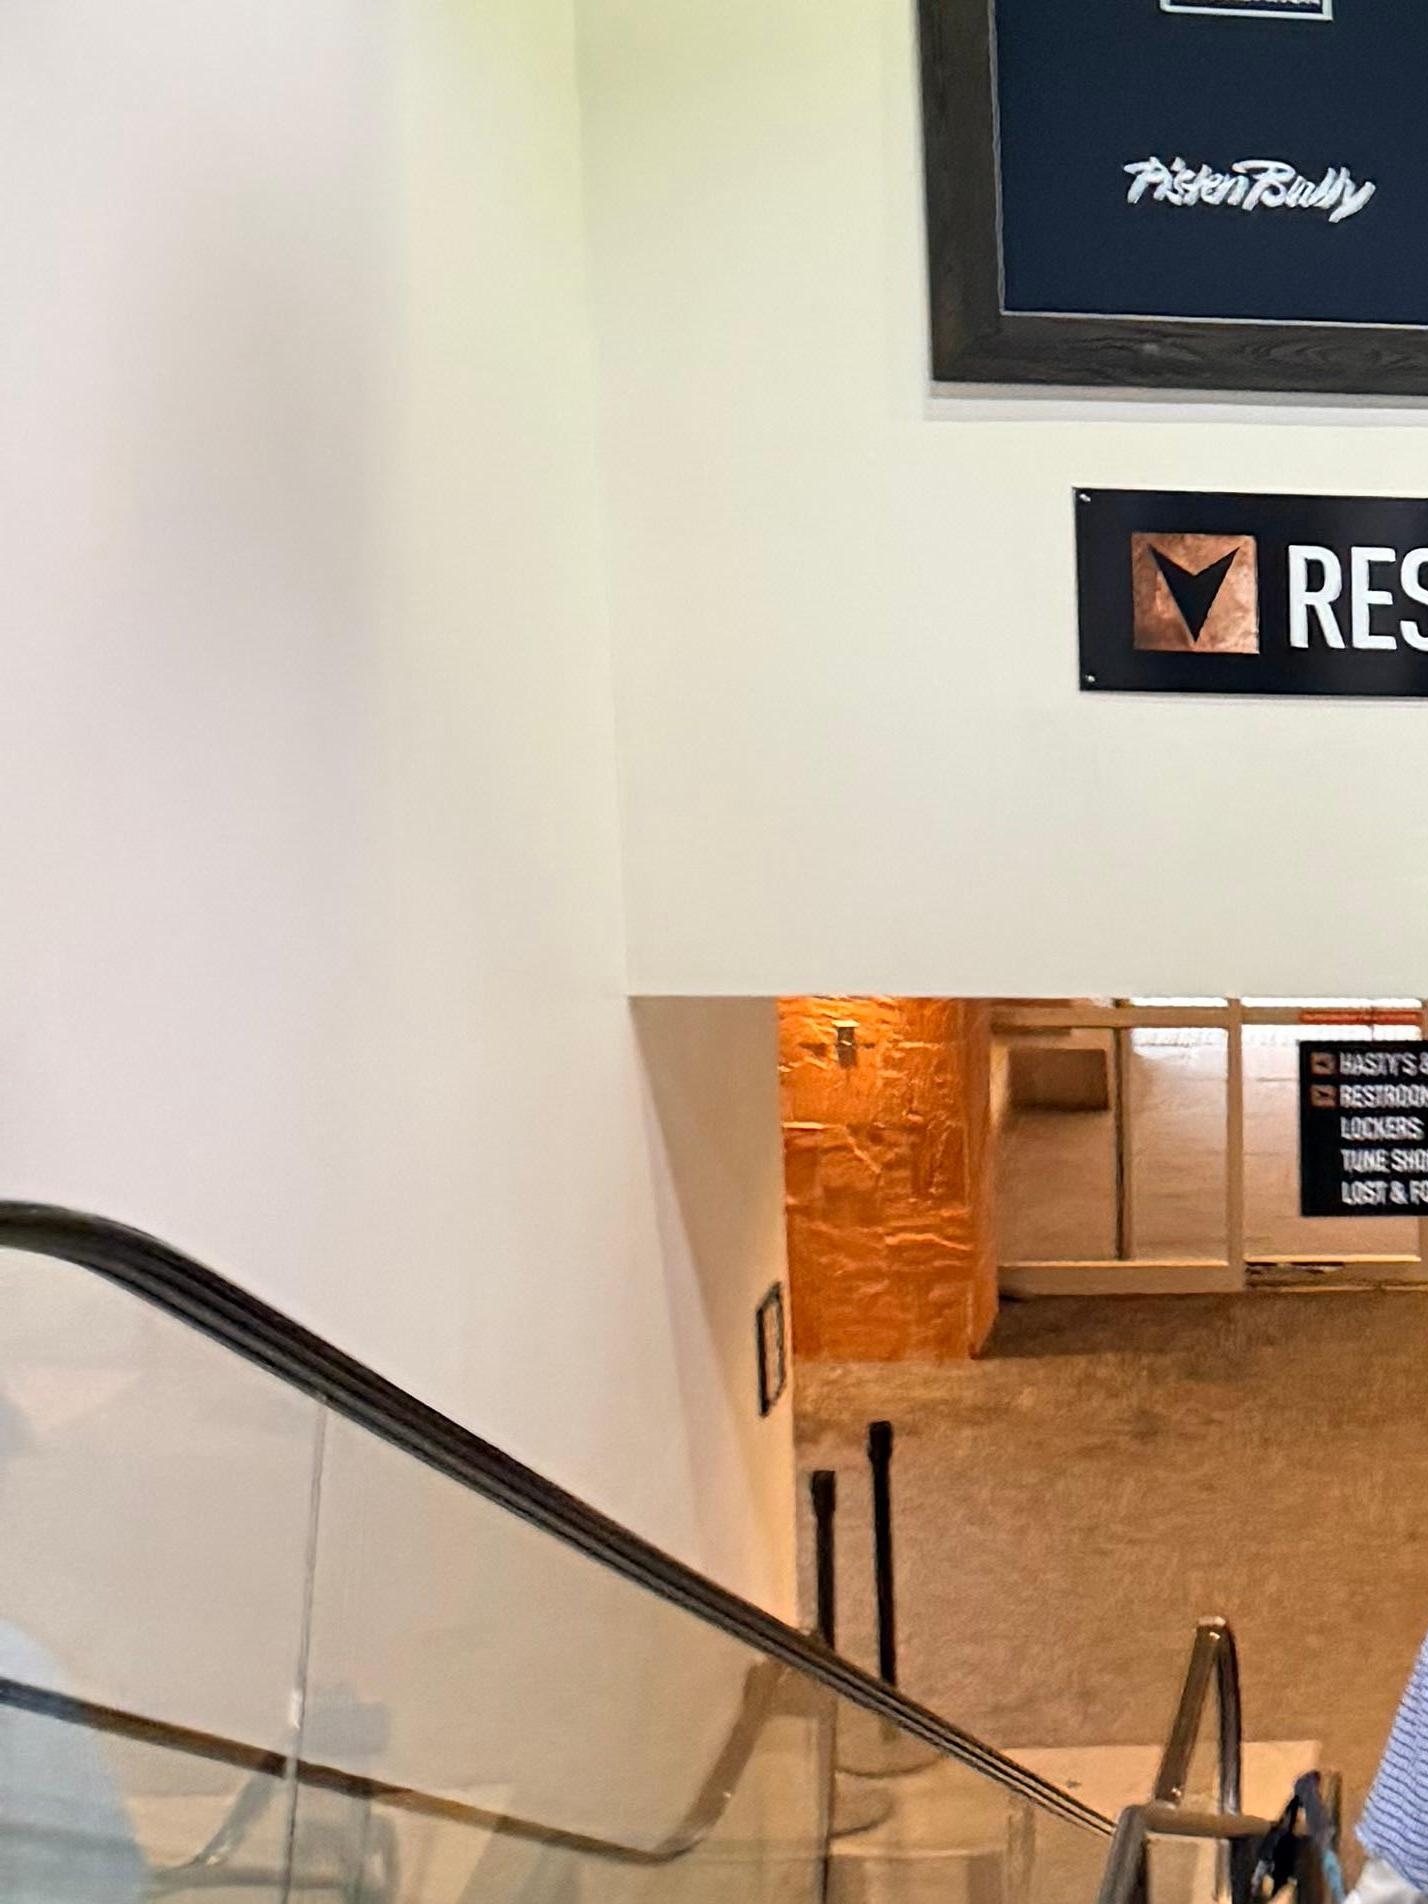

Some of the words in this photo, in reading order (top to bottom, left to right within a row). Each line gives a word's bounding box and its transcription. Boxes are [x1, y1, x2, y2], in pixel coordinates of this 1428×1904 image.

[1340, 1115, 1425, 1141] LOCKERS
[1341, 1148, 1390, 1173] TUNE
[1341, 1180, 1388, 1205] LOST
[1389, 1180, 1408, 1205] &
